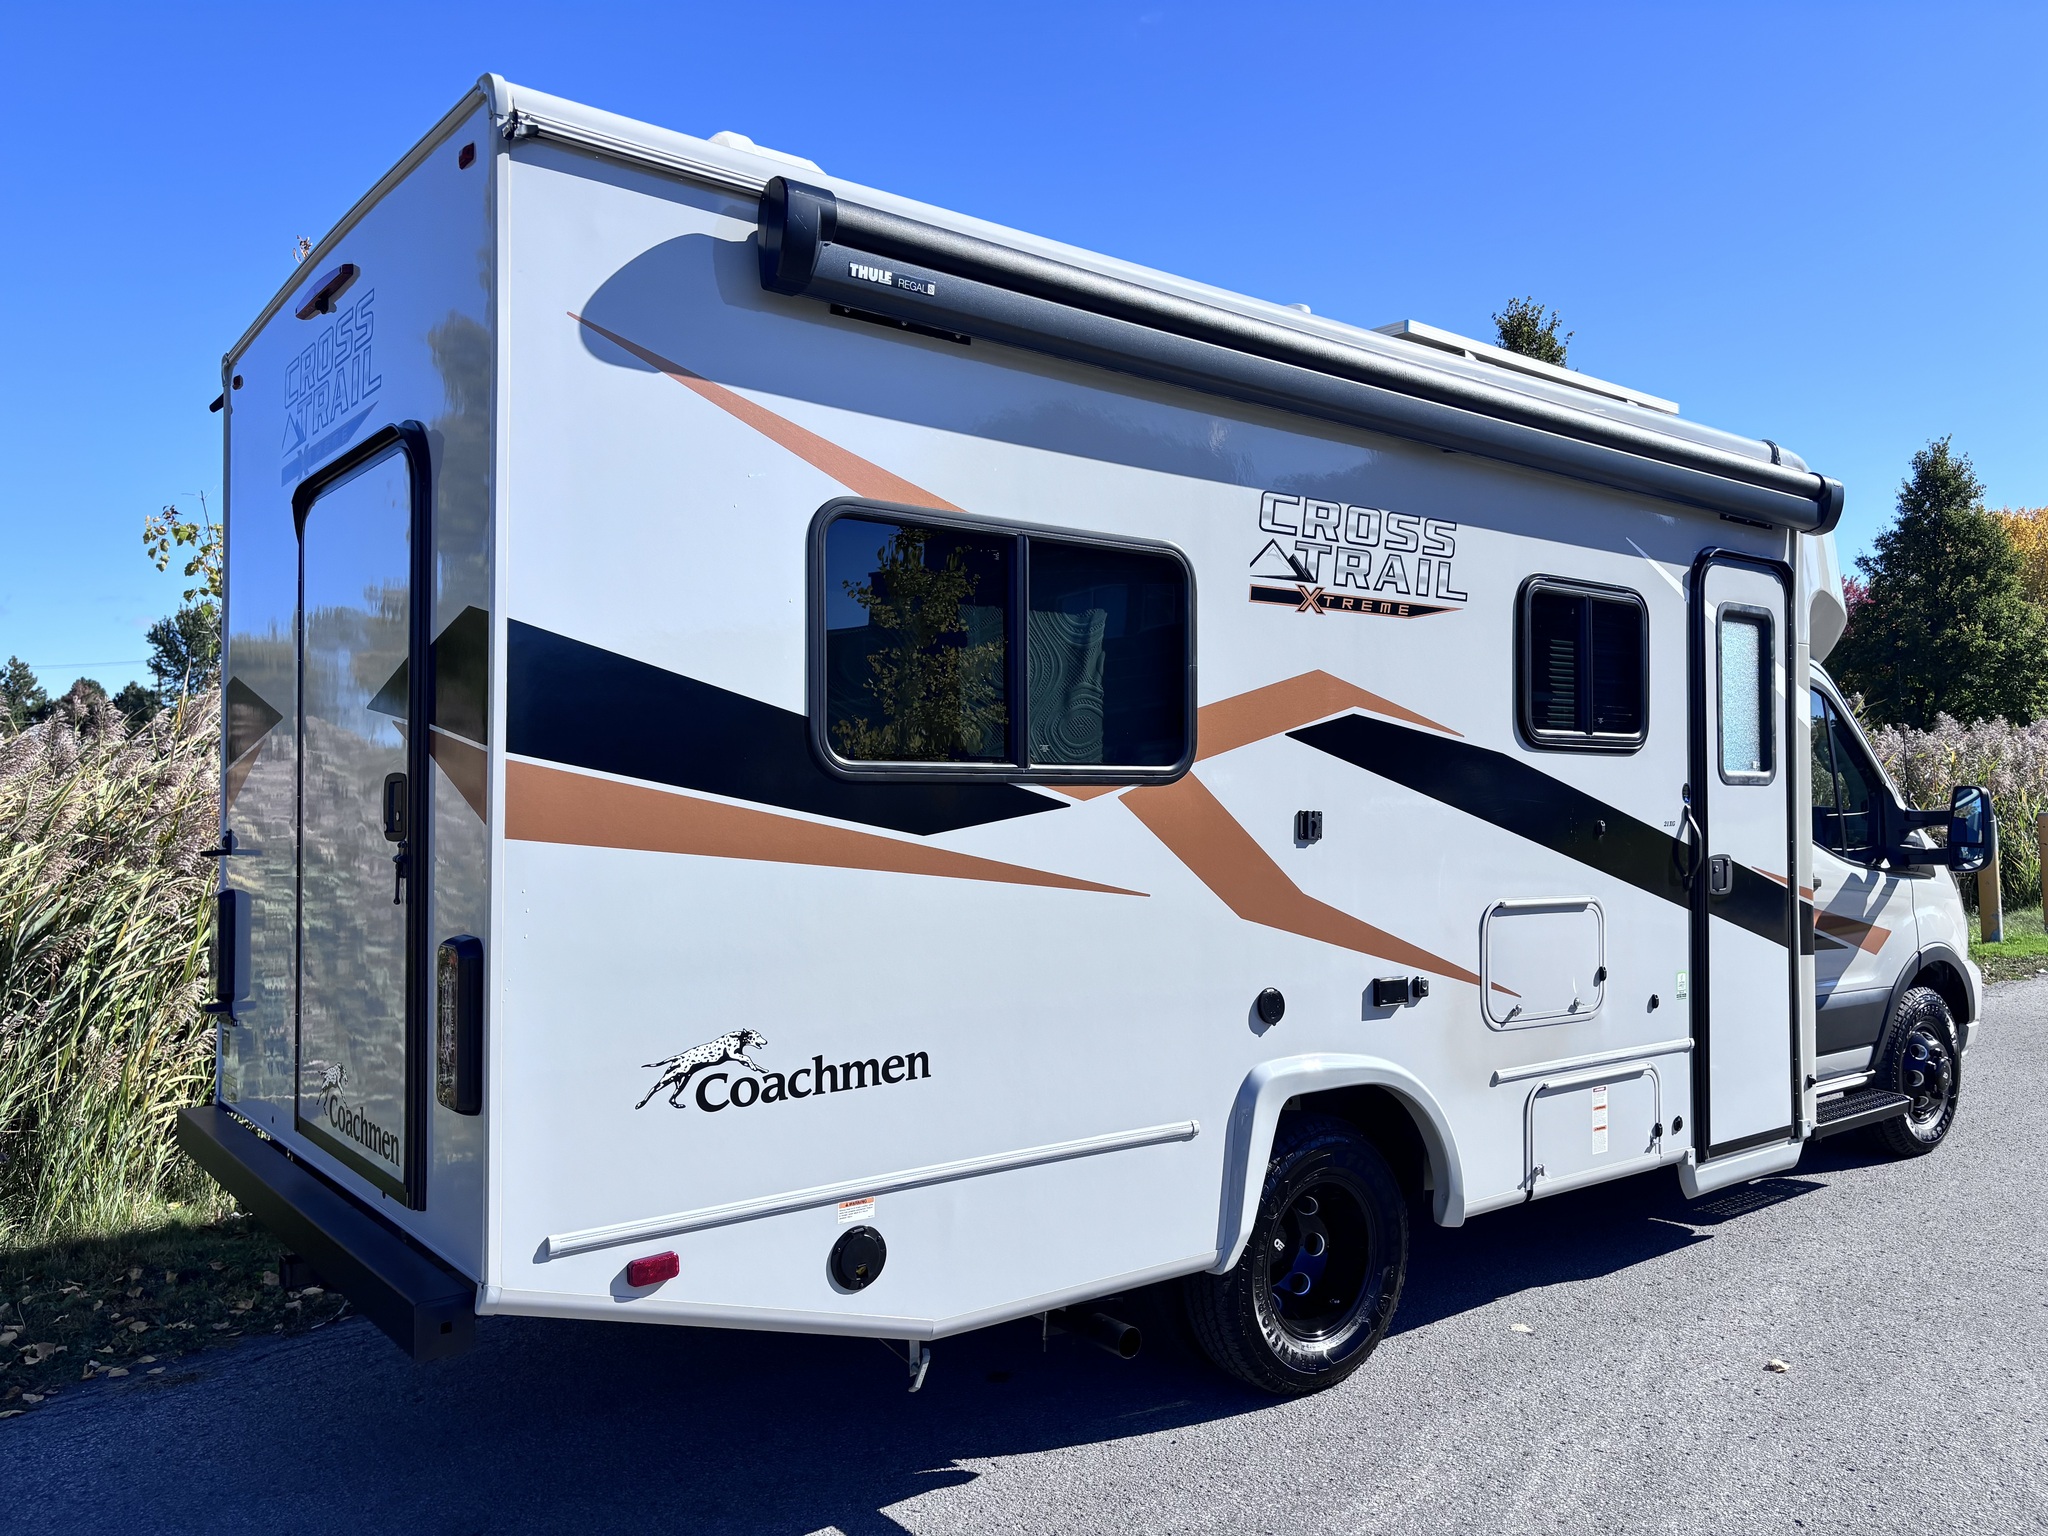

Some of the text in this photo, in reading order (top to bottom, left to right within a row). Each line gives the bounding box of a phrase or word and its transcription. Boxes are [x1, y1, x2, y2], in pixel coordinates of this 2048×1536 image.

[849, 262, 893, 285] THULE
[898, 278, 928, 294] REGAL
[284, 288, 375, 409] CROSS
[297, 345, 382, 441] TRAIL
[1259, 490, 1457, 558] CROSS
[1294, 540, 1468, 602] TRAIL
[1295, 584, 1410, 616] XTREME
[695, 1051, 931, 1113] Coachmen
[329, 1094, 400, 1168] Coachmen
